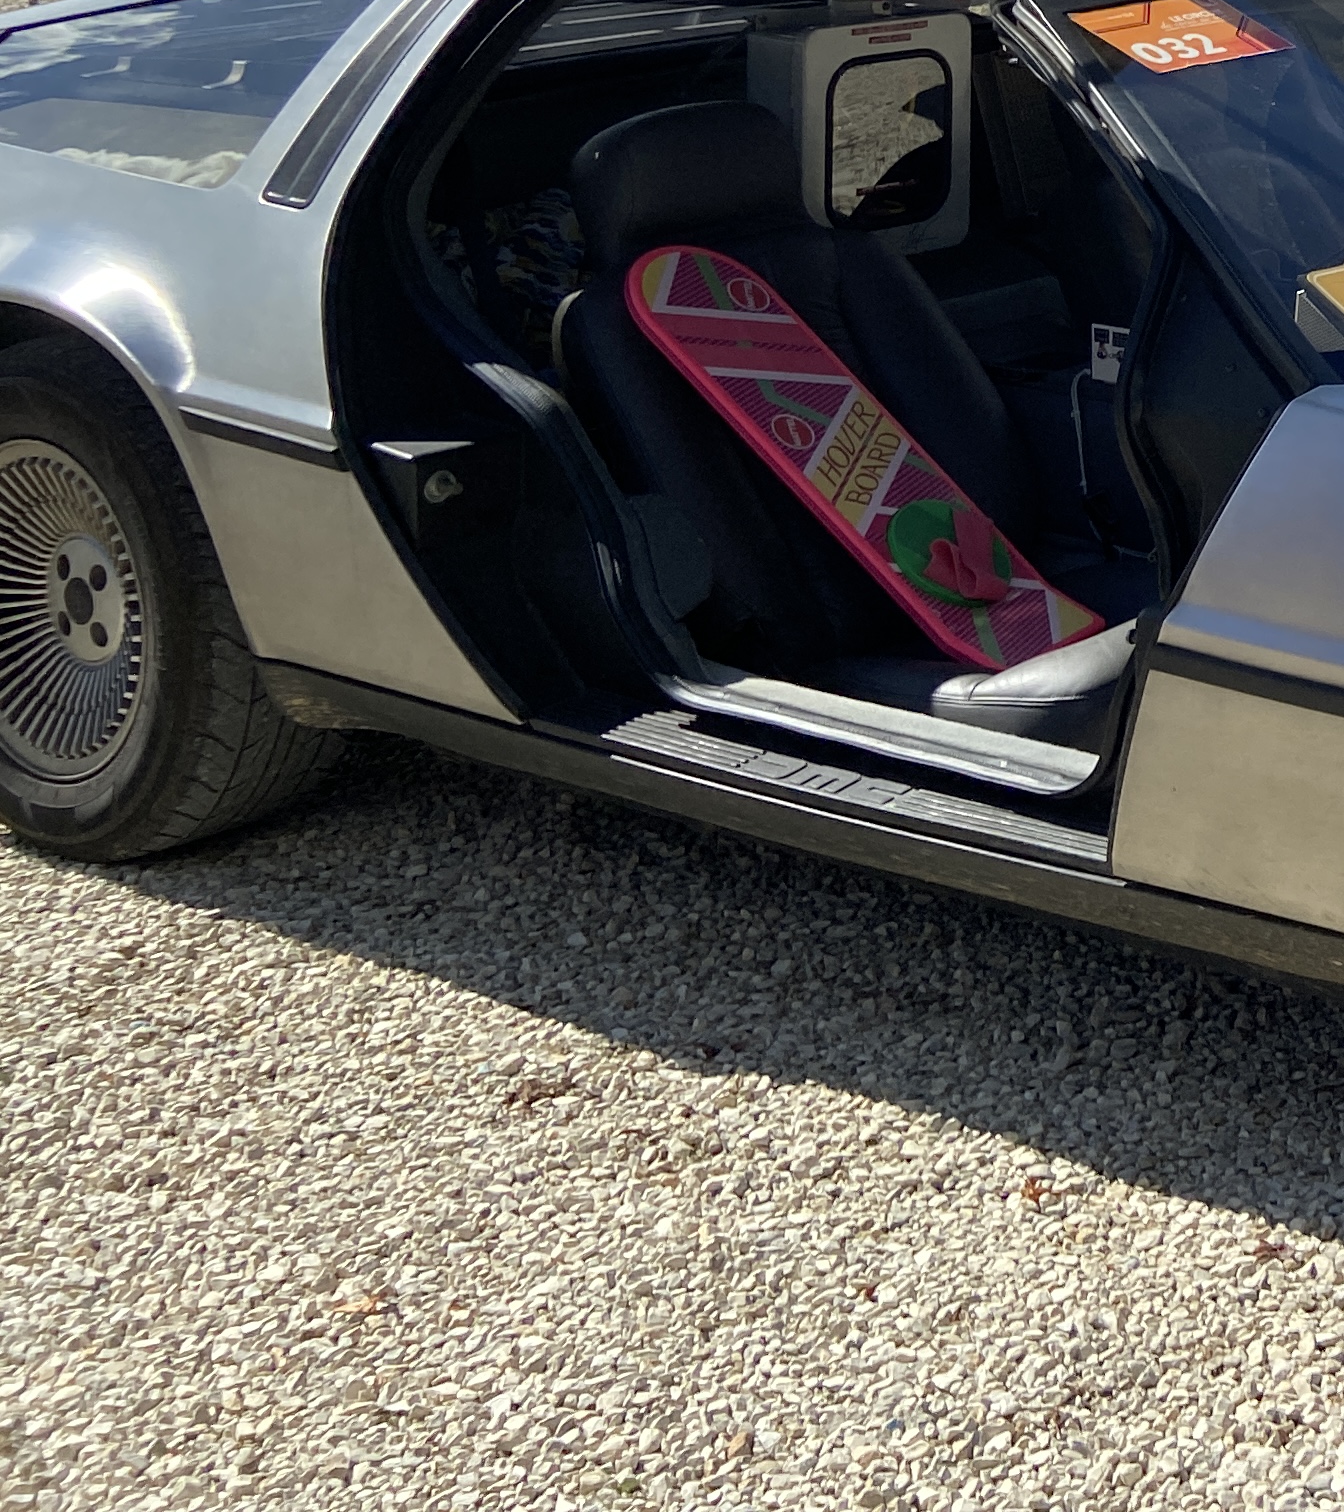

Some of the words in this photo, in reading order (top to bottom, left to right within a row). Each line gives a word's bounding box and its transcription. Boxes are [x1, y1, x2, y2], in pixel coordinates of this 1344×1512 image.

[1131, 33, 1228, 65] 032
[816, 400, 877, 487] HOVER
[844, 432, 902, 506] BOARD
